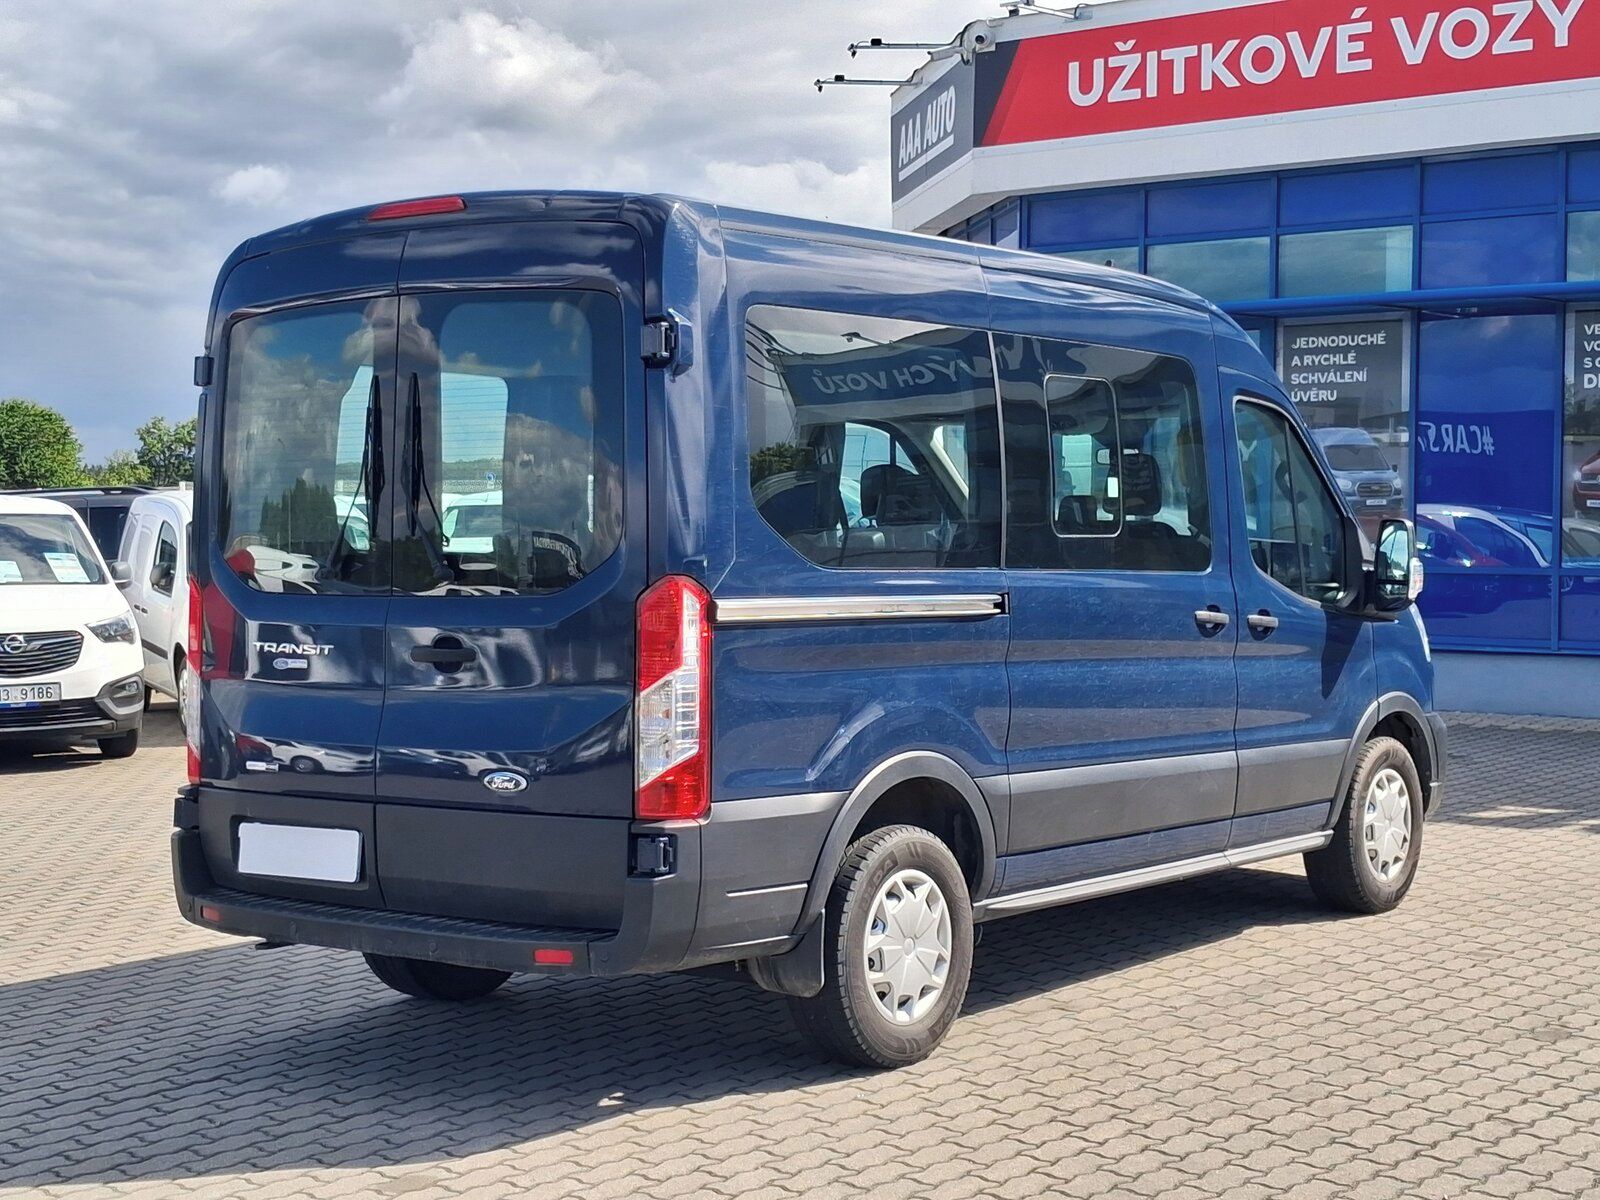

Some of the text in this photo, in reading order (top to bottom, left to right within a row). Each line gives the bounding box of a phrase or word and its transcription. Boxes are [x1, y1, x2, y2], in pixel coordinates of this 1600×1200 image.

[1067, 0, 1584, 107] UŽITKOVÉ VOZY
[898, 85, 956, 169] AAA AUTO
[1291, 330, 1386, 349] JEDNODUCHÉ
[1291, 350, 1356, 367] A RYCHLÉ
[1583, 357, 1593, 369] S
[1291, 367, 1368, 385] SCHVÁLENÍ
[1583, 373, 1600, 389] D
[1291, 387, 1337, 402] ÚVĚRU
[252, 641, 335, 655] TRANSIT
[20, 686, 53, 701] 9186
